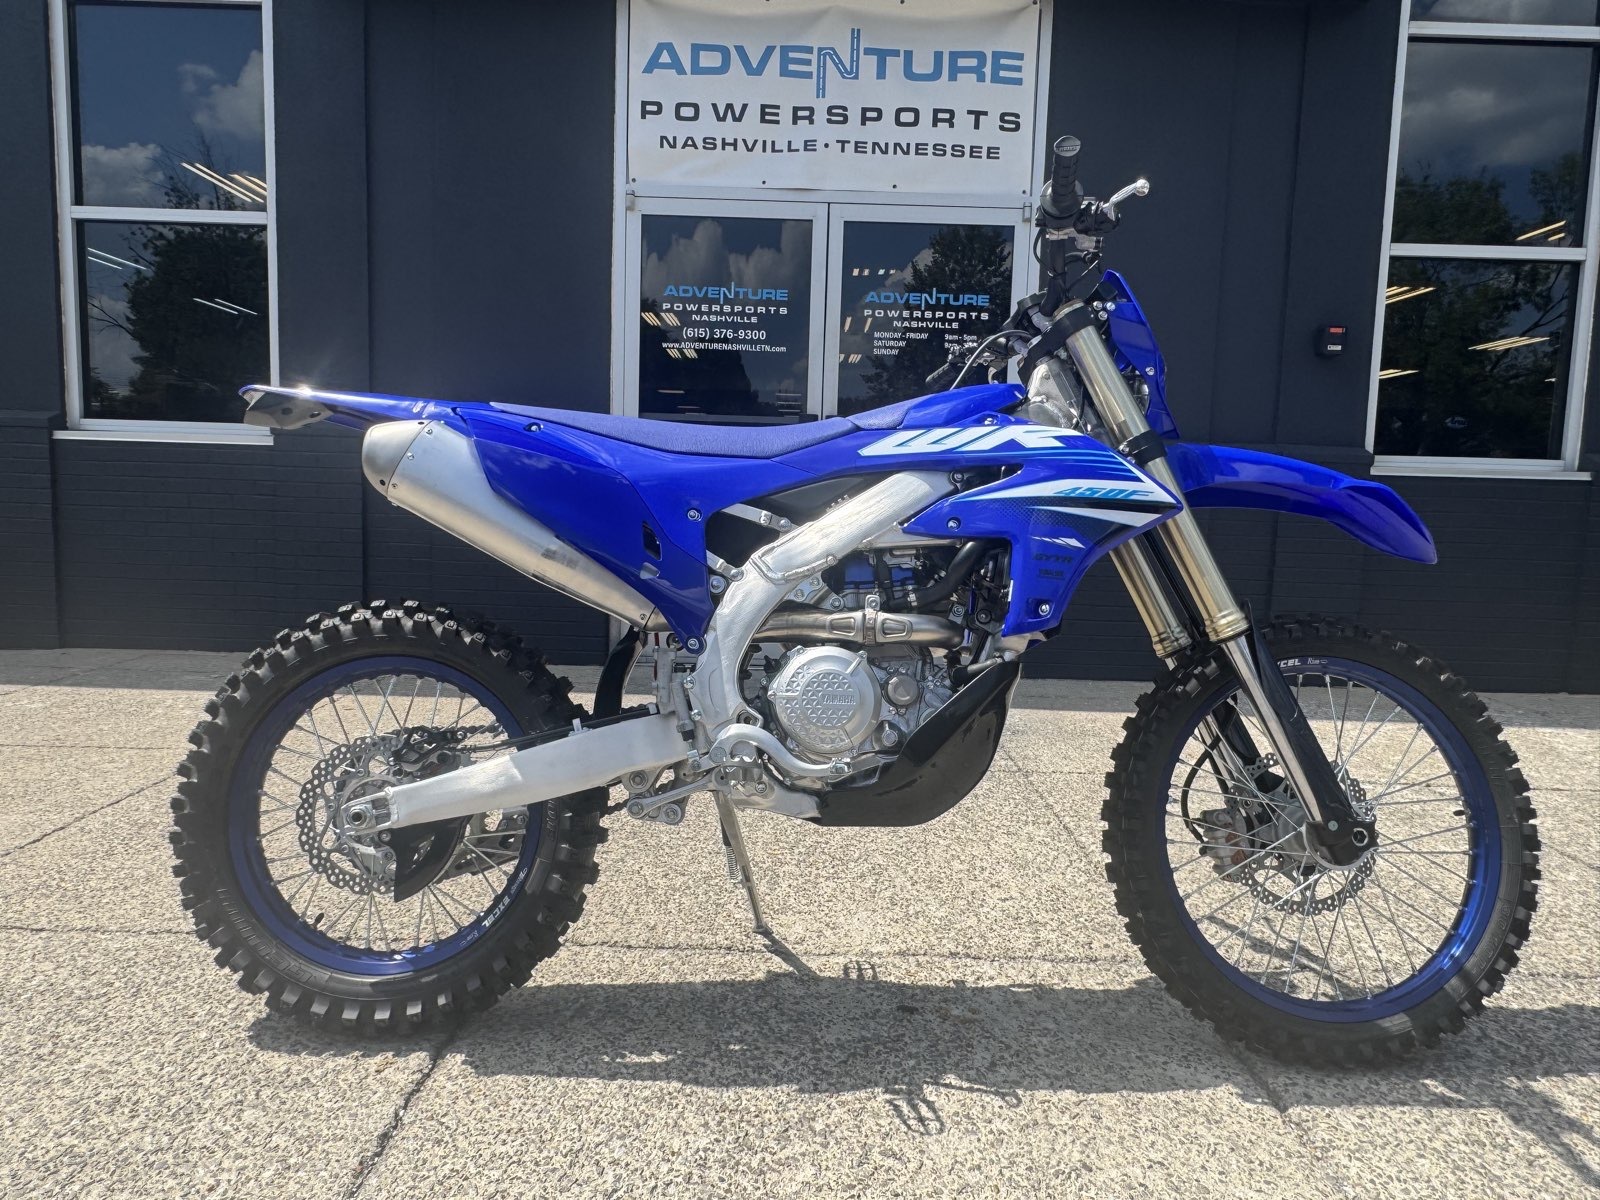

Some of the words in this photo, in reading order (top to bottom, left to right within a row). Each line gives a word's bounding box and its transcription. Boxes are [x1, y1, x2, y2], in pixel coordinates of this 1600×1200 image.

[641, 28, 1025, 98] ADVENTURE
[640, 100, 1021, 132] POWERSPORTS
[659, 135, 818, 153] NASHVILLE
[836, 139, 1001, 160] TENNESSEE
[663, 282, 789, 304] ADVENTURE
[865, 288, 990, 310] ADVENTURE
[662, 303, 788, 314] POWERSPORTS
[864, 309, 989, 320] POWERSPORTS
[692, 314, 758, 323] NASHVILLE
[893, 320, 959, 329] NASHVILLE
[682, 327, 710, 340] (615)
[713, 328, 767, 340] 376-9300
[661, 341, 787, 353] www.ADVENTURENASHVILLETN.com
[1053, 486, 1155, 499] 450F
